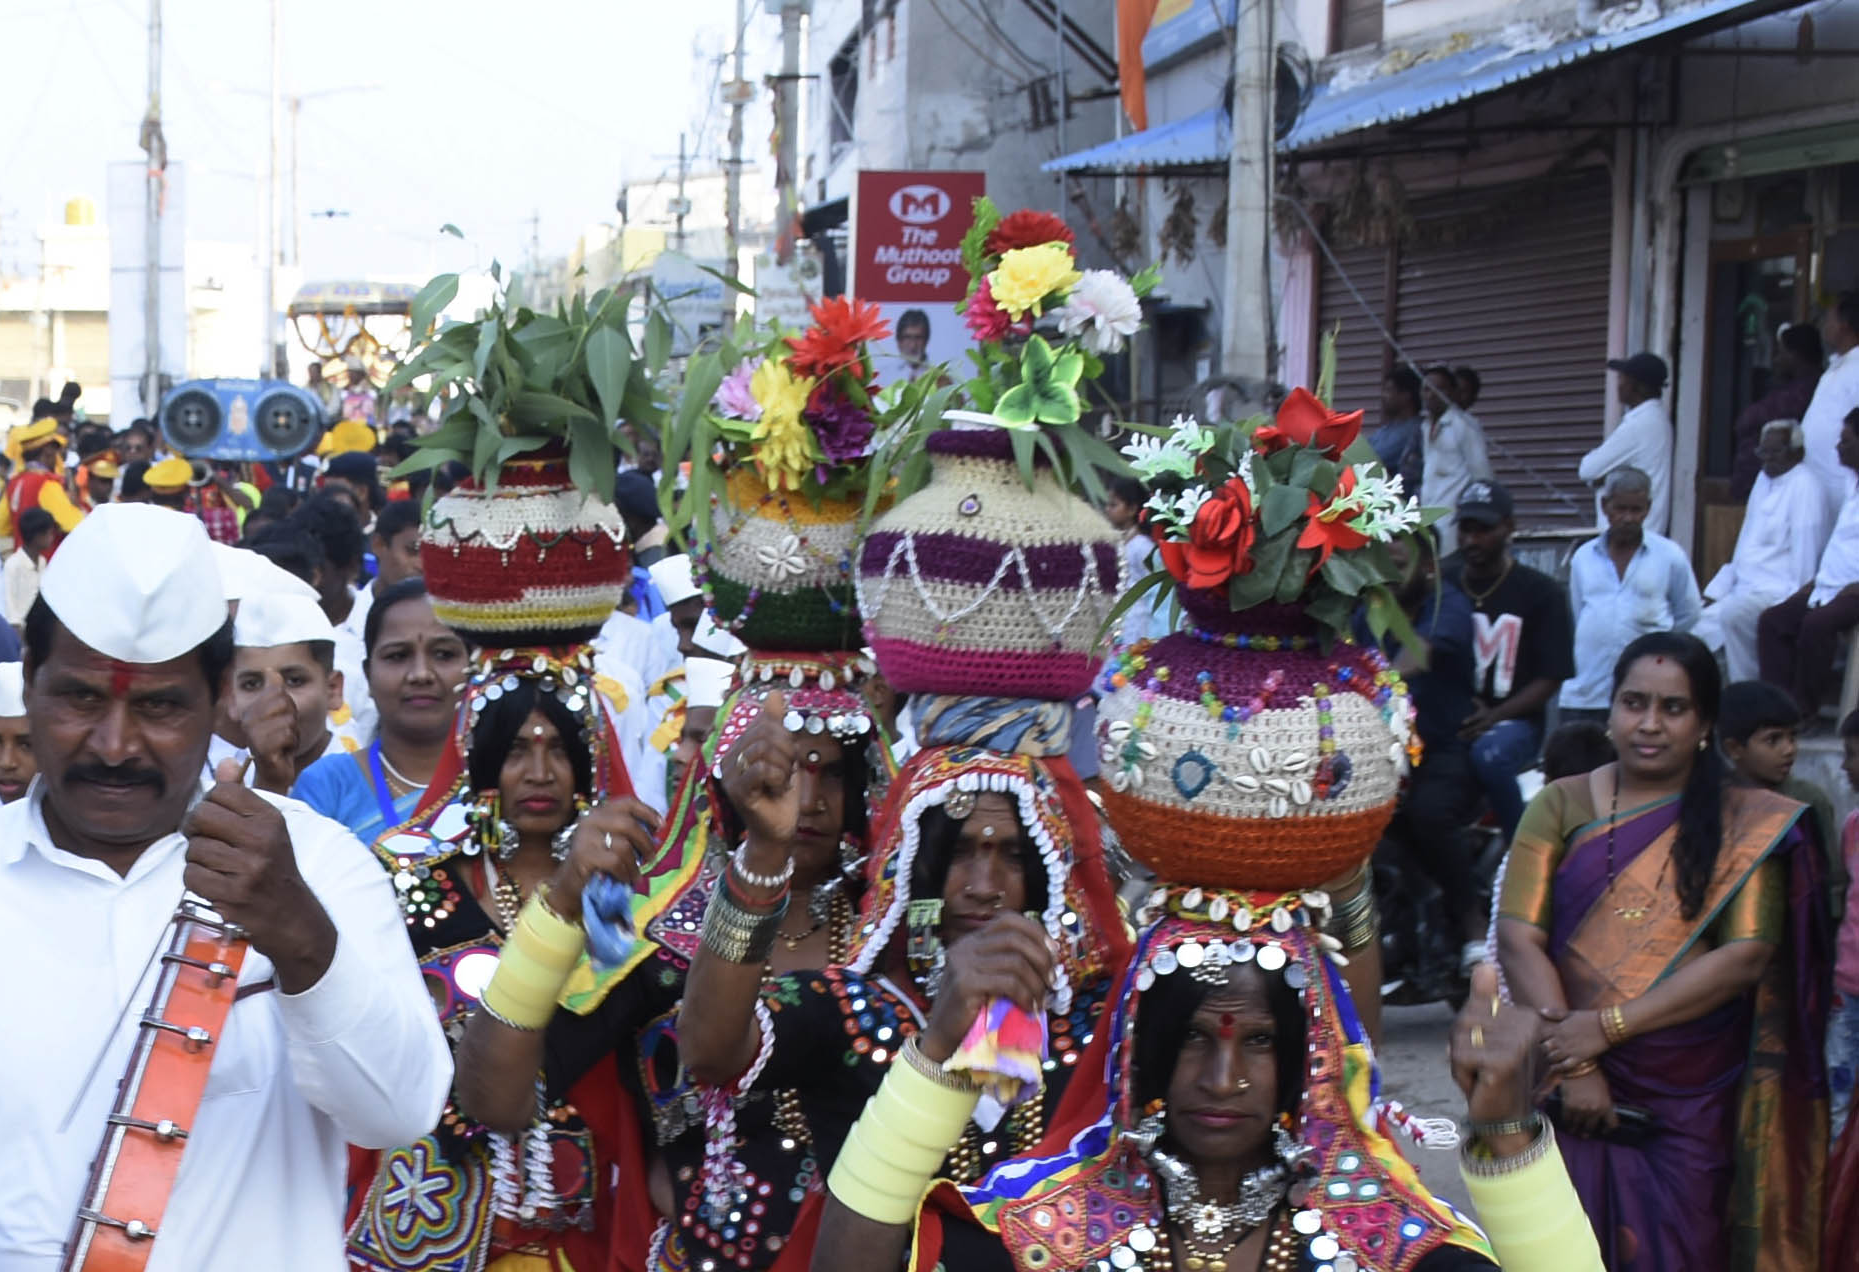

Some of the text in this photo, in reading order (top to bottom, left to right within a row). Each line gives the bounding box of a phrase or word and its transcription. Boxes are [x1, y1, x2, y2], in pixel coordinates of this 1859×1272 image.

[902, 226, 939, 246] The
[873, 245, 963, 265] Muthoot
[886, 264, 951, 289] Group
[1472, 612, 1523, 699] M
